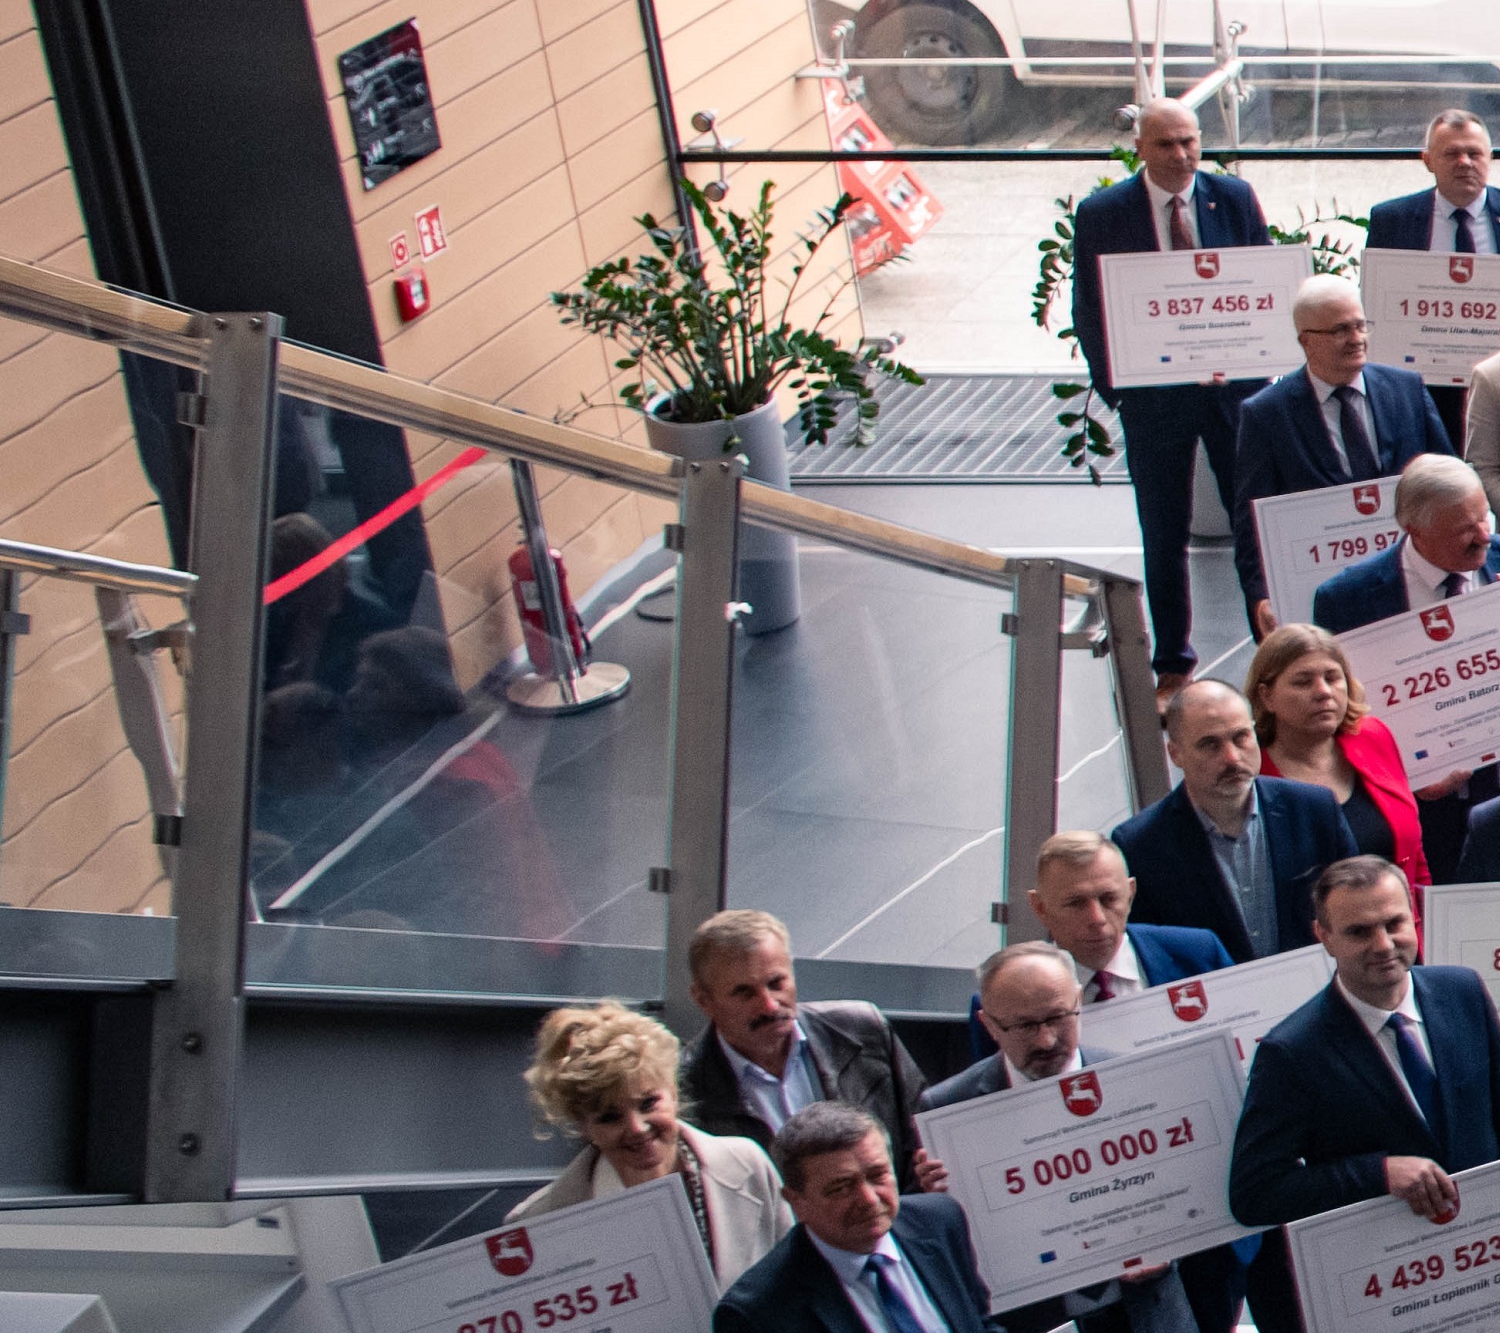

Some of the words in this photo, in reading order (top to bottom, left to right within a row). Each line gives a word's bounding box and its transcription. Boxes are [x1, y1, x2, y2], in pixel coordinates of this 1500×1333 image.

[1382, 684, 1400, 706] 2
[1404, 666, 1450, 699] 226
[1456, 649, 1500, 680] 655
[1433, 694, 1467, 712] Gmina
[1364, 1273, 1382, 1298] 4
[1391, 1255, 1444, 1289] 439
[1390, 1297, 1431, 1317] Gmina
